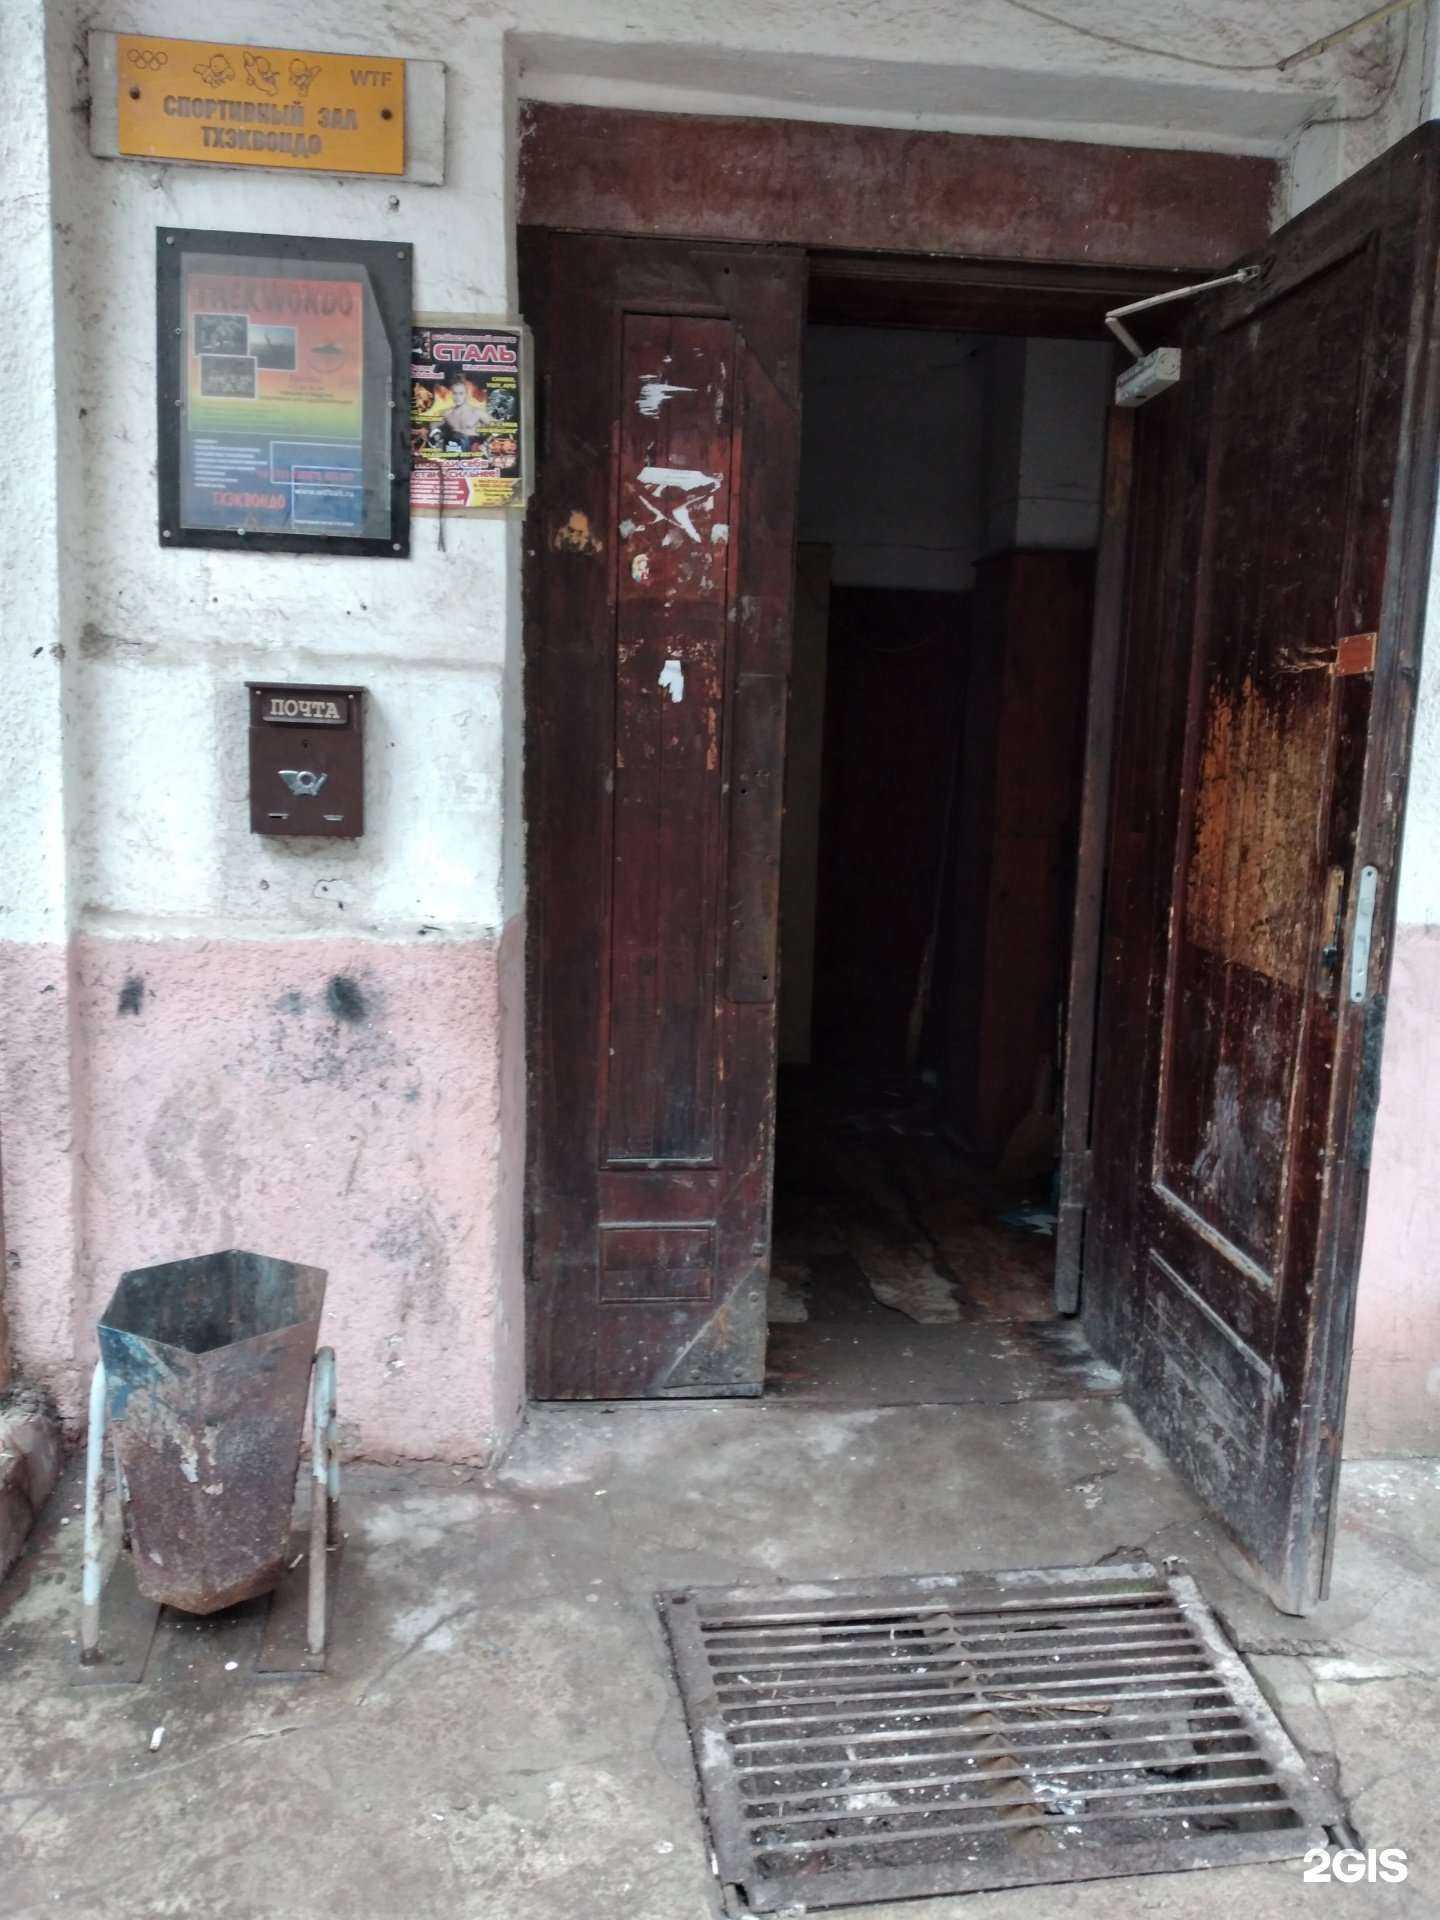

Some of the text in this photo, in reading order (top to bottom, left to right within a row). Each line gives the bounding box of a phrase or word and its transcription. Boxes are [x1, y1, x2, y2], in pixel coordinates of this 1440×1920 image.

[350, 69, 393, 87] WTF
[163, 94, 359, 131] СПОРТИВНЫЙ ЗАЛ
[201, 125, 324, 159] ТХЭКВОНДО
[191, 280, 355, 316] TAEKWONDO
[433, 343, 516, 362] СТАЛЬ
[270, 698, 340, 719] ПОЧТА
